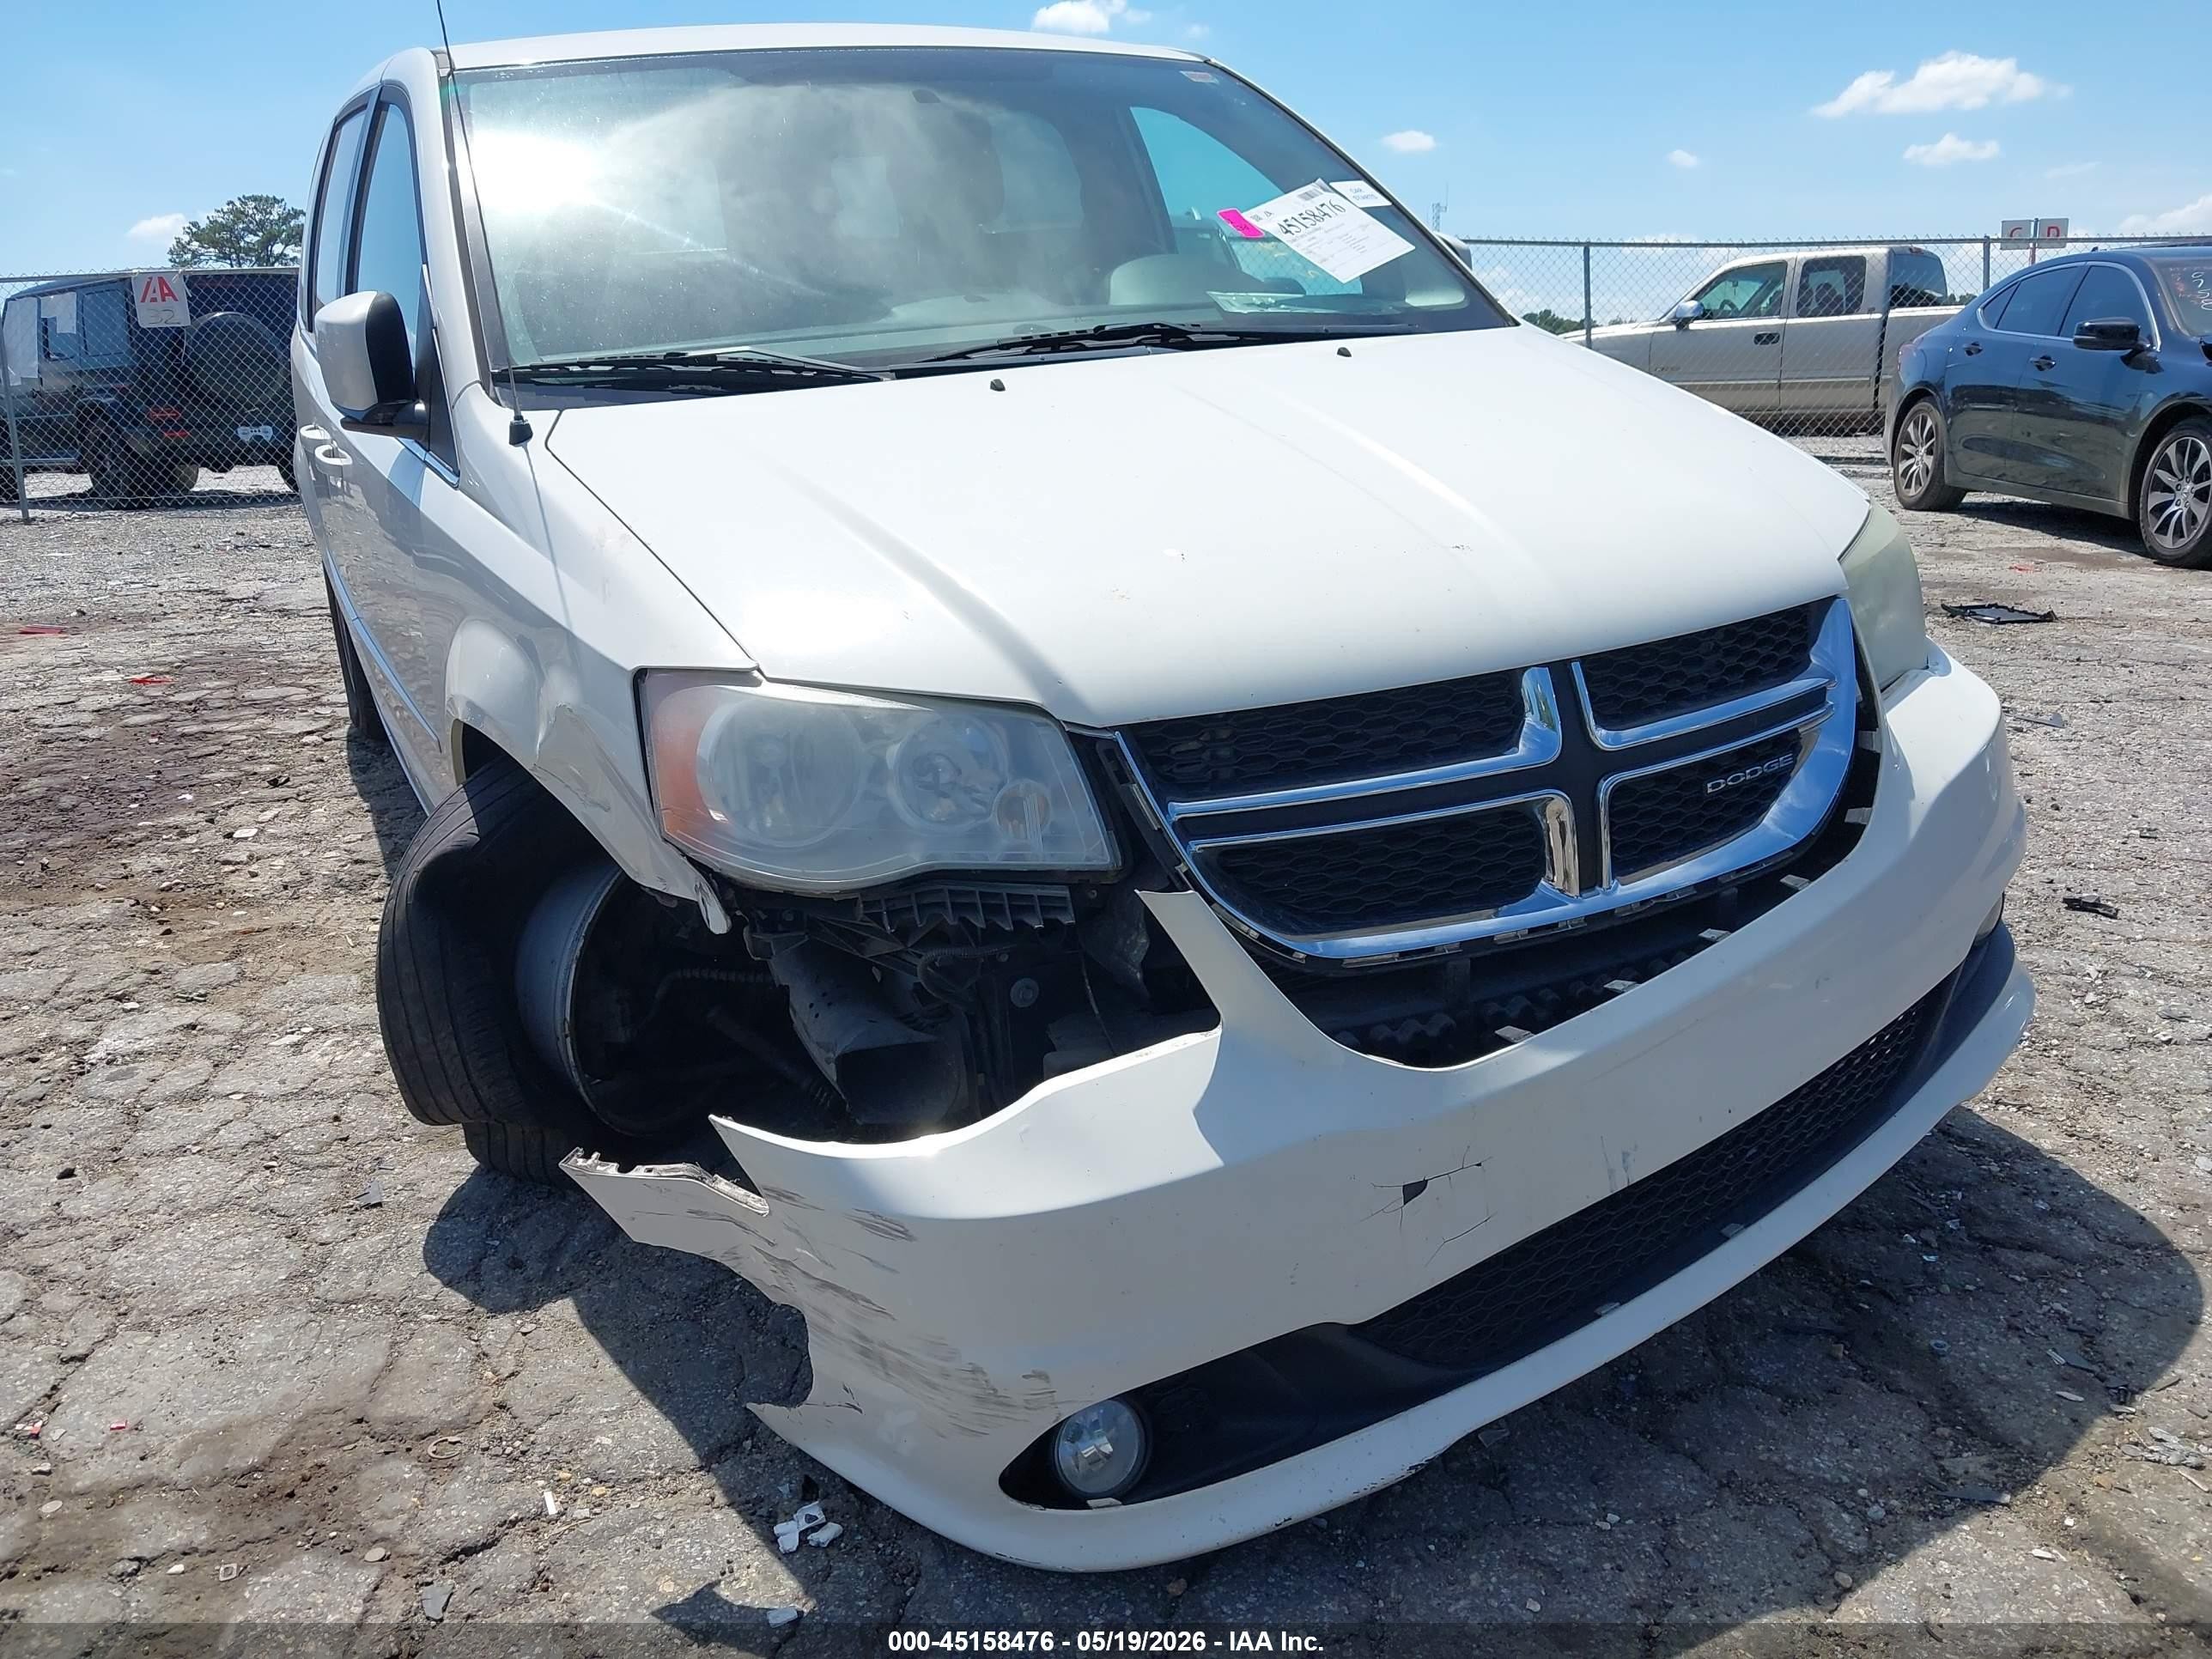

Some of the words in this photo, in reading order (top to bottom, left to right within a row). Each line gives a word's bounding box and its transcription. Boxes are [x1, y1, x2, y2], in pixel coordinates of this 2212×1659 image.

[1277, 199, 1346, 235] 45158476
[148, 308, 181, 325] 32
[1706, 753, 1795, 794] DODGE
